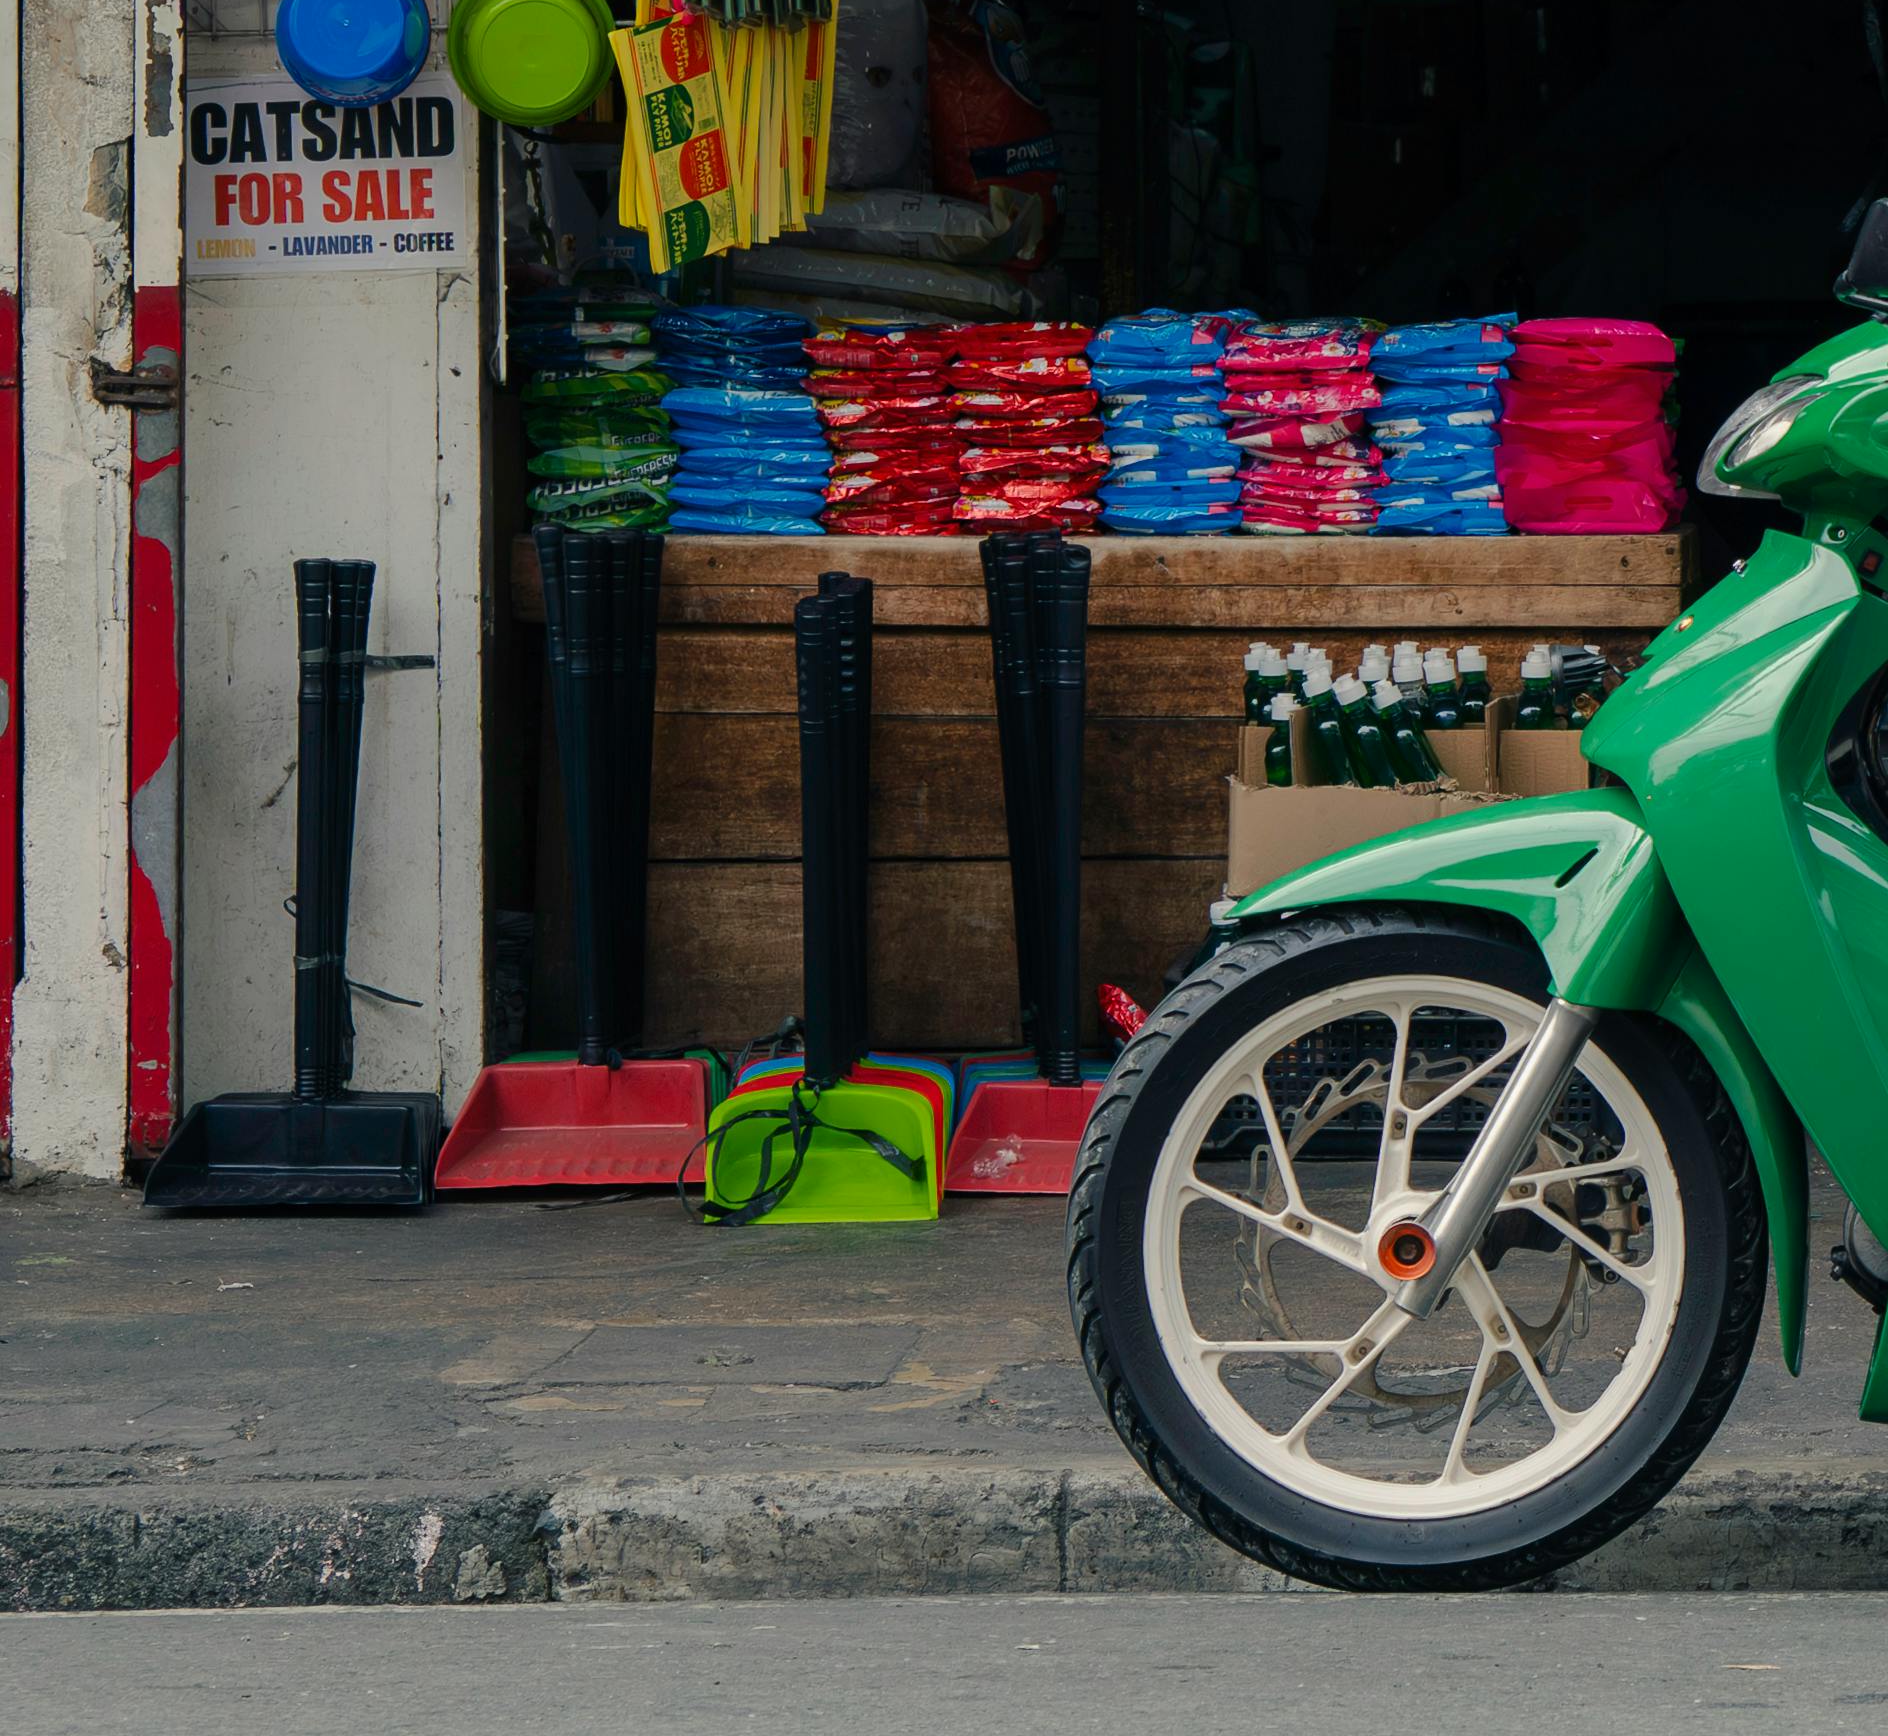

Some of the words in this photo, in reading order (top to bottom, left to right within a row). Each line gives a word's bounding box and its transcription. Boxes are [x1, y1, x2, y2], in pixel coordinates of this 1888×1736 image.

[190, 97, 455, 165] CATSAND
[215, 172, 304, 226] FOR
[322, 168, 435, 223] SALE
[197, 238, 256, 259] LEMON
[283, 234, 373, 256] LAVANDER
[393, 232, 455, 252] COFFEE
